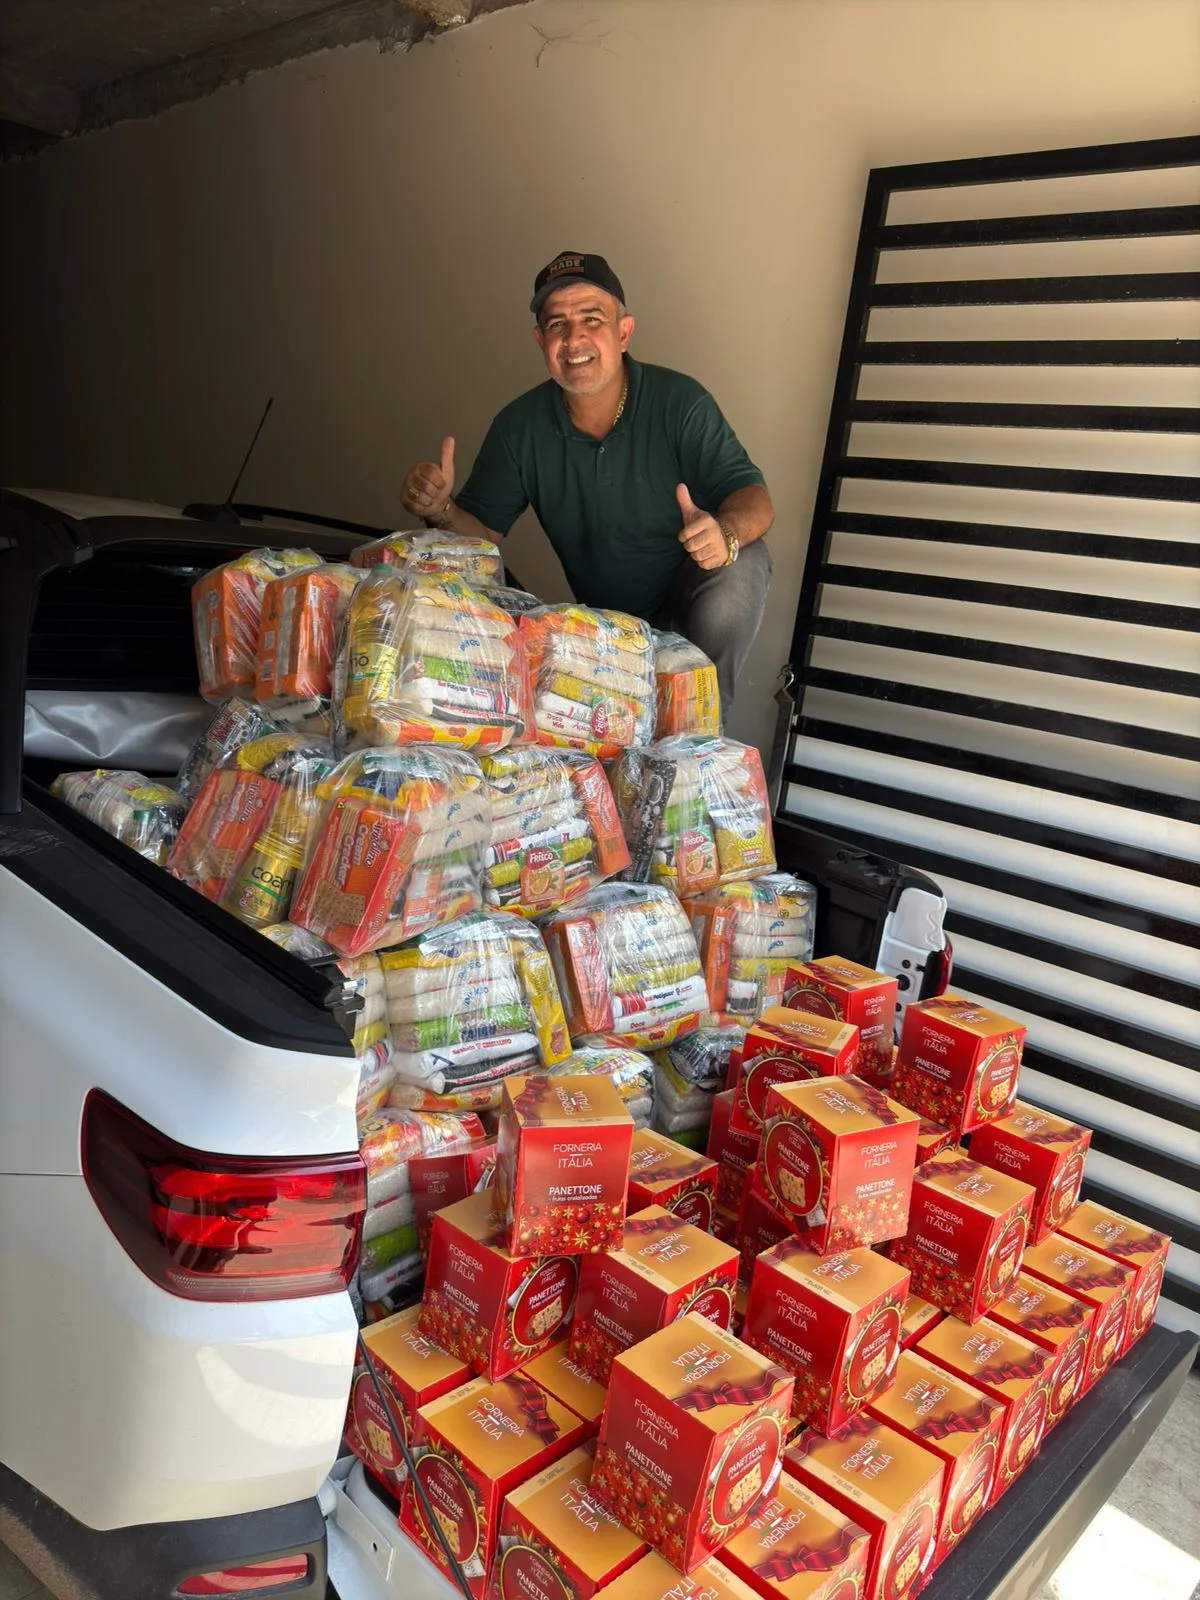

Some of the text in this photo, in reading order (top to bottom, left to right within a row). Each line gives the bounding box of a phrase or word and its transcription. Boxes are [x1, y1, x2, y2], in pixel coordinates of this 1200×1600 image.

[550, 259, 581, 273] MADE
[353, 823, 368, 866] Cream
[365, 820, 385, 867] Trigolino
[530, 852, 553, 863] FRISCO
[337, 834, 354, 886] Cracker
[863, 995, 887, 1006] FORNERIA
[921, 1026, 956, 1046] FORNERIA
[775, 1061, 799, 1073] FORNERIA
[914, 1056, 951, 1078] PANETTONE
[553, 1142, 602, 1153] FORNERIA
[721, 1149, 749, 1168] PANETTO
[777, 1142, 810, 1174] PANETTONE
[861, 1141, 897, 1156] FORNERIA
[994, 1140, 1031, 1162] FORNERIA
[549, 1184, 602, 1196] PANETTONE
[855, 1177, 896, 1194] PANETTONE
[923, 1200, 965, 1227] FORNERIA
[449, 1243, 484, 1273] FORNERIA
[638, 1232, 685, 1257] FORNERIA
[915, 1233, 959, 1262] PANETTONE
[443, 1280, 480, 1313] PANETTONE
[528, 1278, 566, 1304] PANETTONE
[600, 1269, 638, 1301] FORNERIA
[776, 1289, 818, 1321] FORNERIA
[593, 1308, 635, 1343] PANETTONE
[767, 1327, 813, 1362] PANETTONE
[861, 1328, 892, 1357] PANETTONE
[681, 1350, 732, 1385] FORNERIA
[363, 1391, 390, 1424] PANETTO
[914, 1384, 951, 1417] FORNERIA
[477, 1397, 526, 1438] FORNERIA
[634, 1398, 680, 1440] FORNERIA
[624, 1441, 673, 1487] PANETTONE
[727, 1441, 768, 1476] PANETTONE
[841, 1438, 883, 1473] FORNERIA
[426, 1475, 465, 1519] PANETTONE
[568, 1478, 622, 1529] FORNERIA
[759, 1509, 807, 1549] FORNERIA
[516, 1568, 550, 1600] PANETTO
[529, 1554, 555, 1582] FORNERIA
